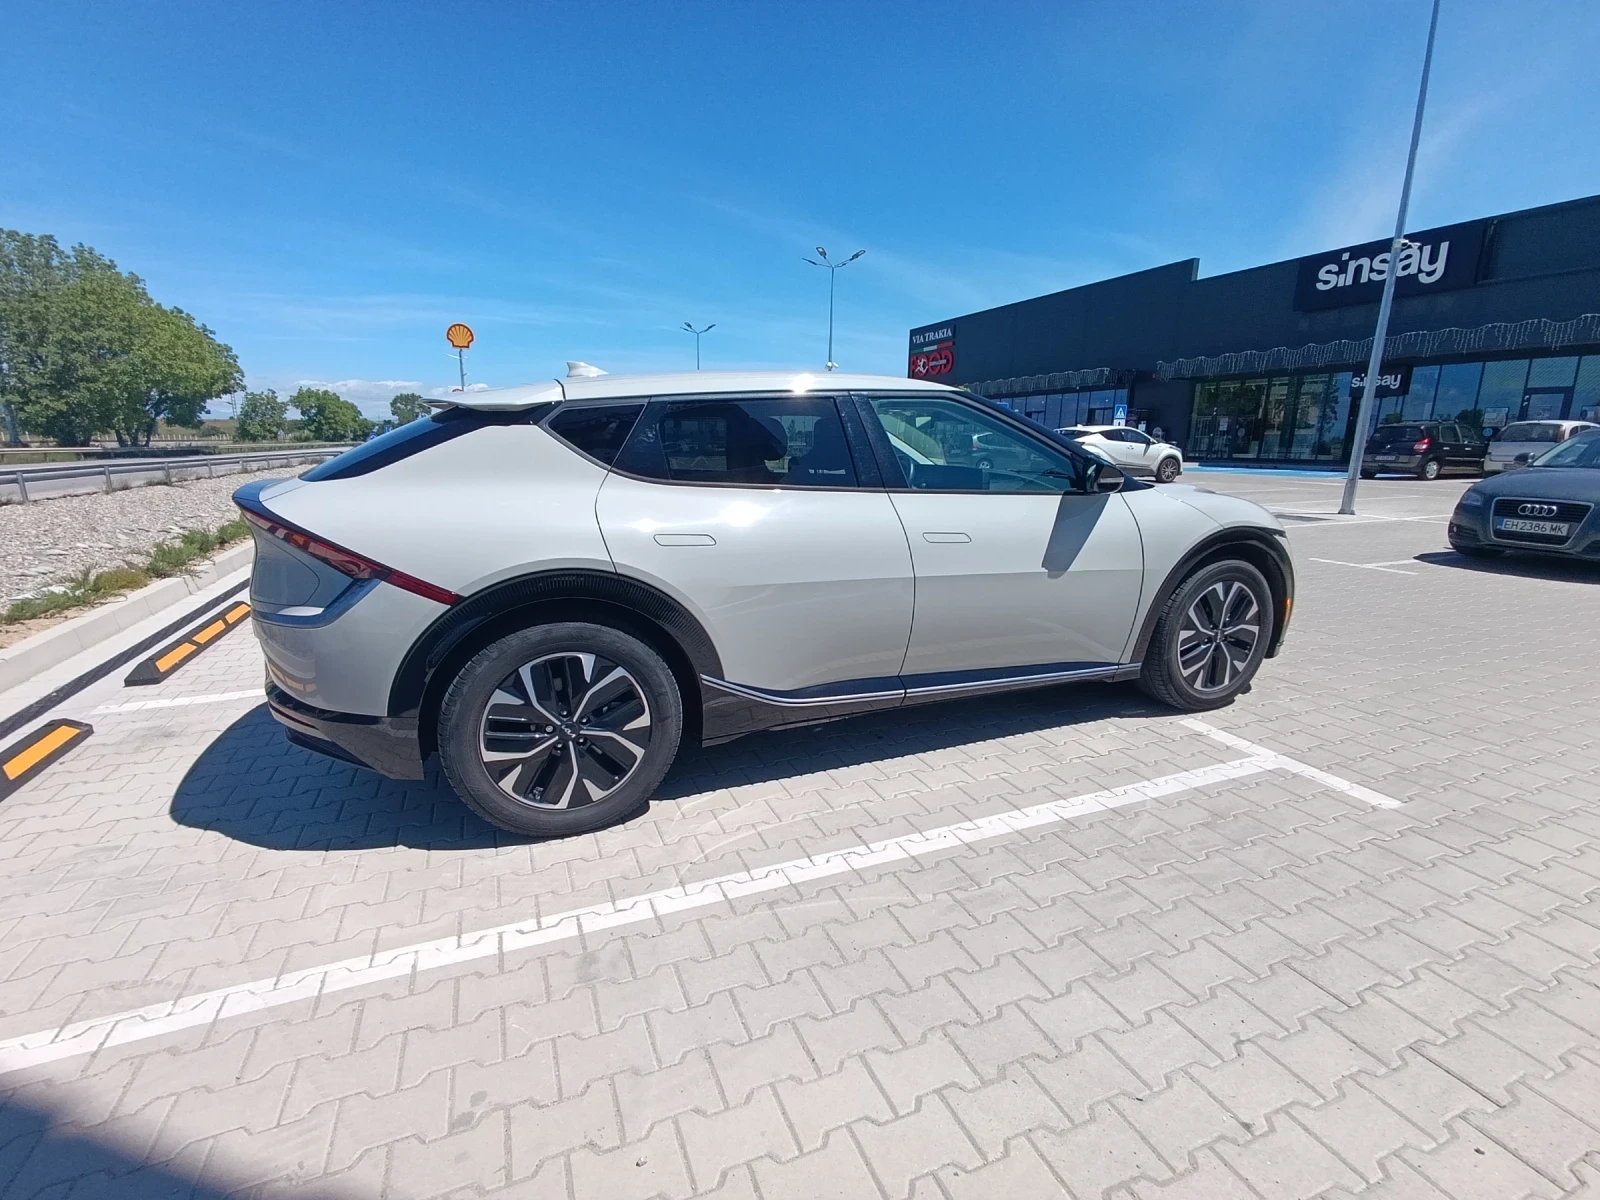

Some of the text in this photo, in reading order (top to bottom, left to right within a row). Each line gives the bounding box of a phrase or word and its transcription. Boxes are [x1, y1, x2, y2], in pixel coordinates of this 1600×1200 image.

[1316, 241, 1450, 290] sinsay
[912, 328, 952, 344] VIA TRAKIA
[1504, 520, 1564, 534] EH 2386 MK
